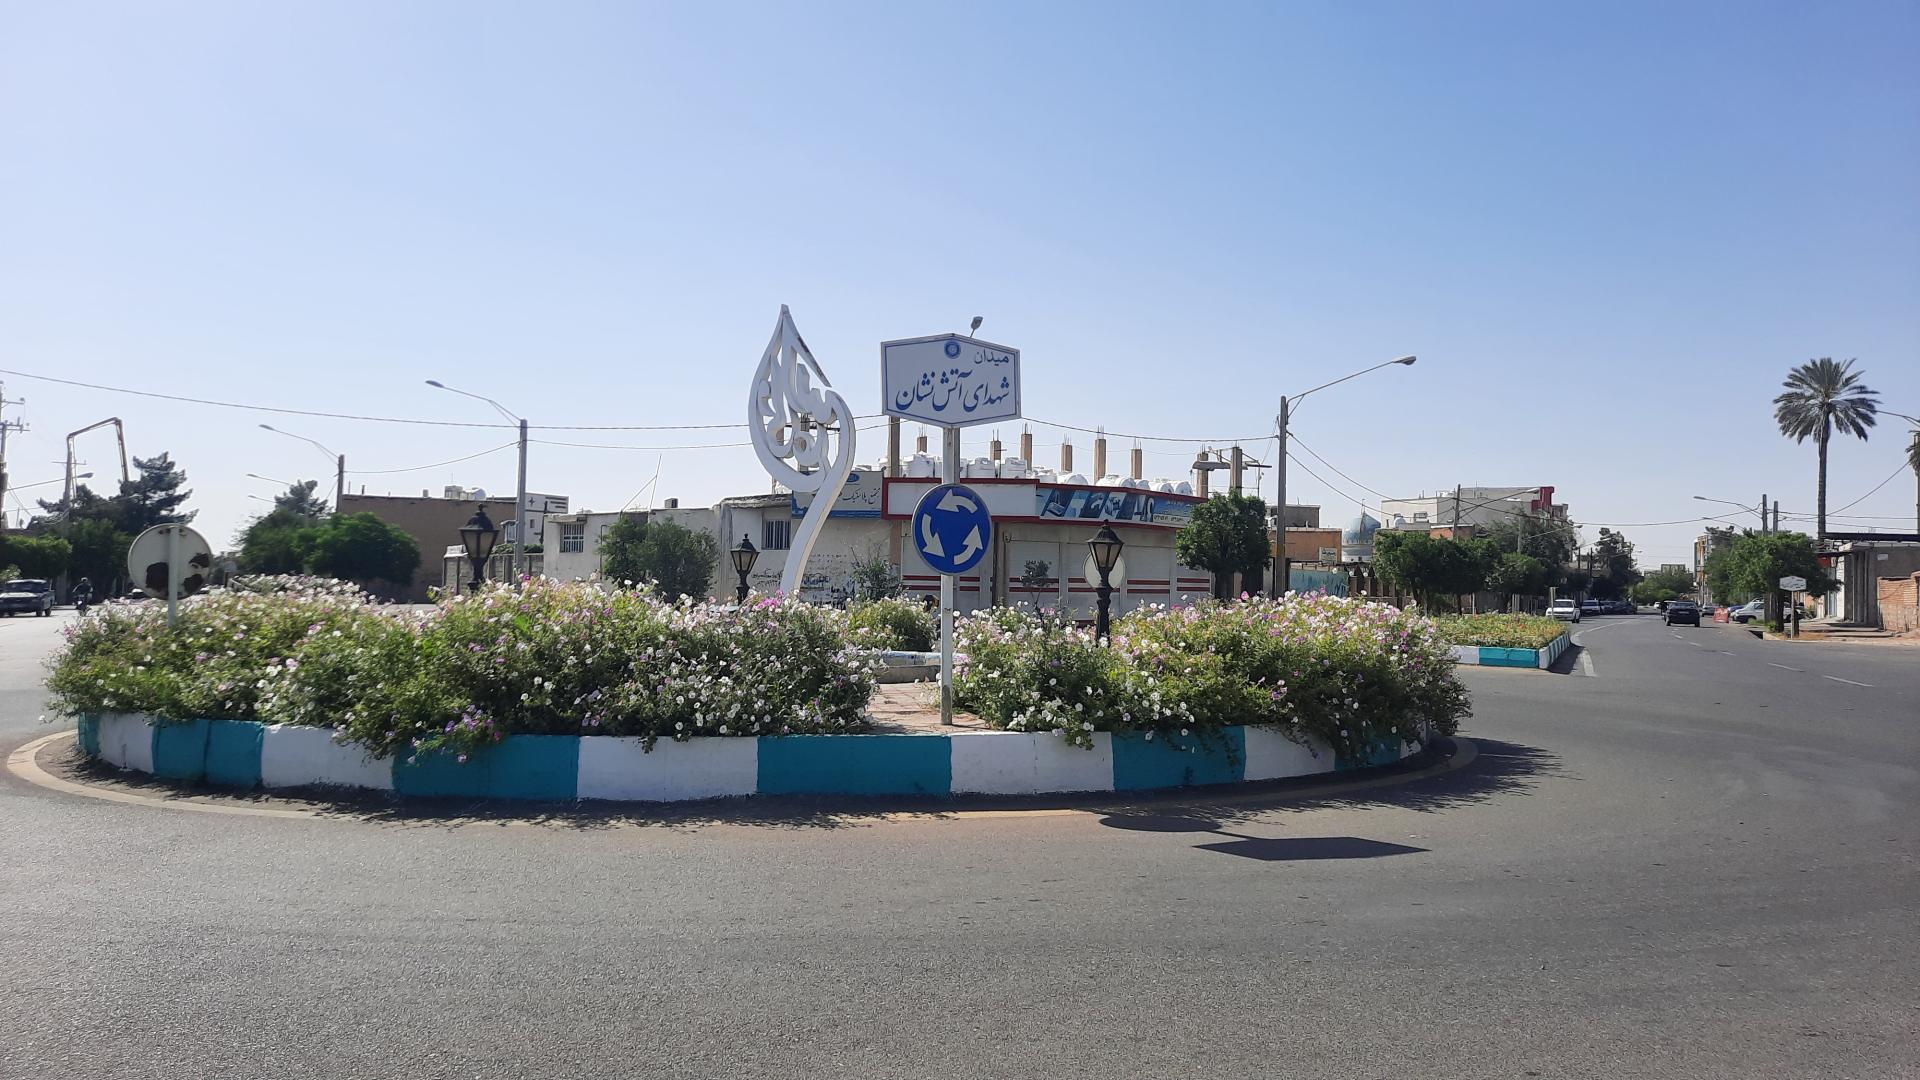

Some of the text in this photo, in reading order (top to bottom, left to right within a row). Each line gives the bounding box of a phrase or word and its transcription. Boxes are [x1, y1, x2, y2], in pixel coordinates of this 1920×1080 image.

[974, 348, 1009, 366] میدان
[895, 368, 1009, 412] شهدای آتش نشان
